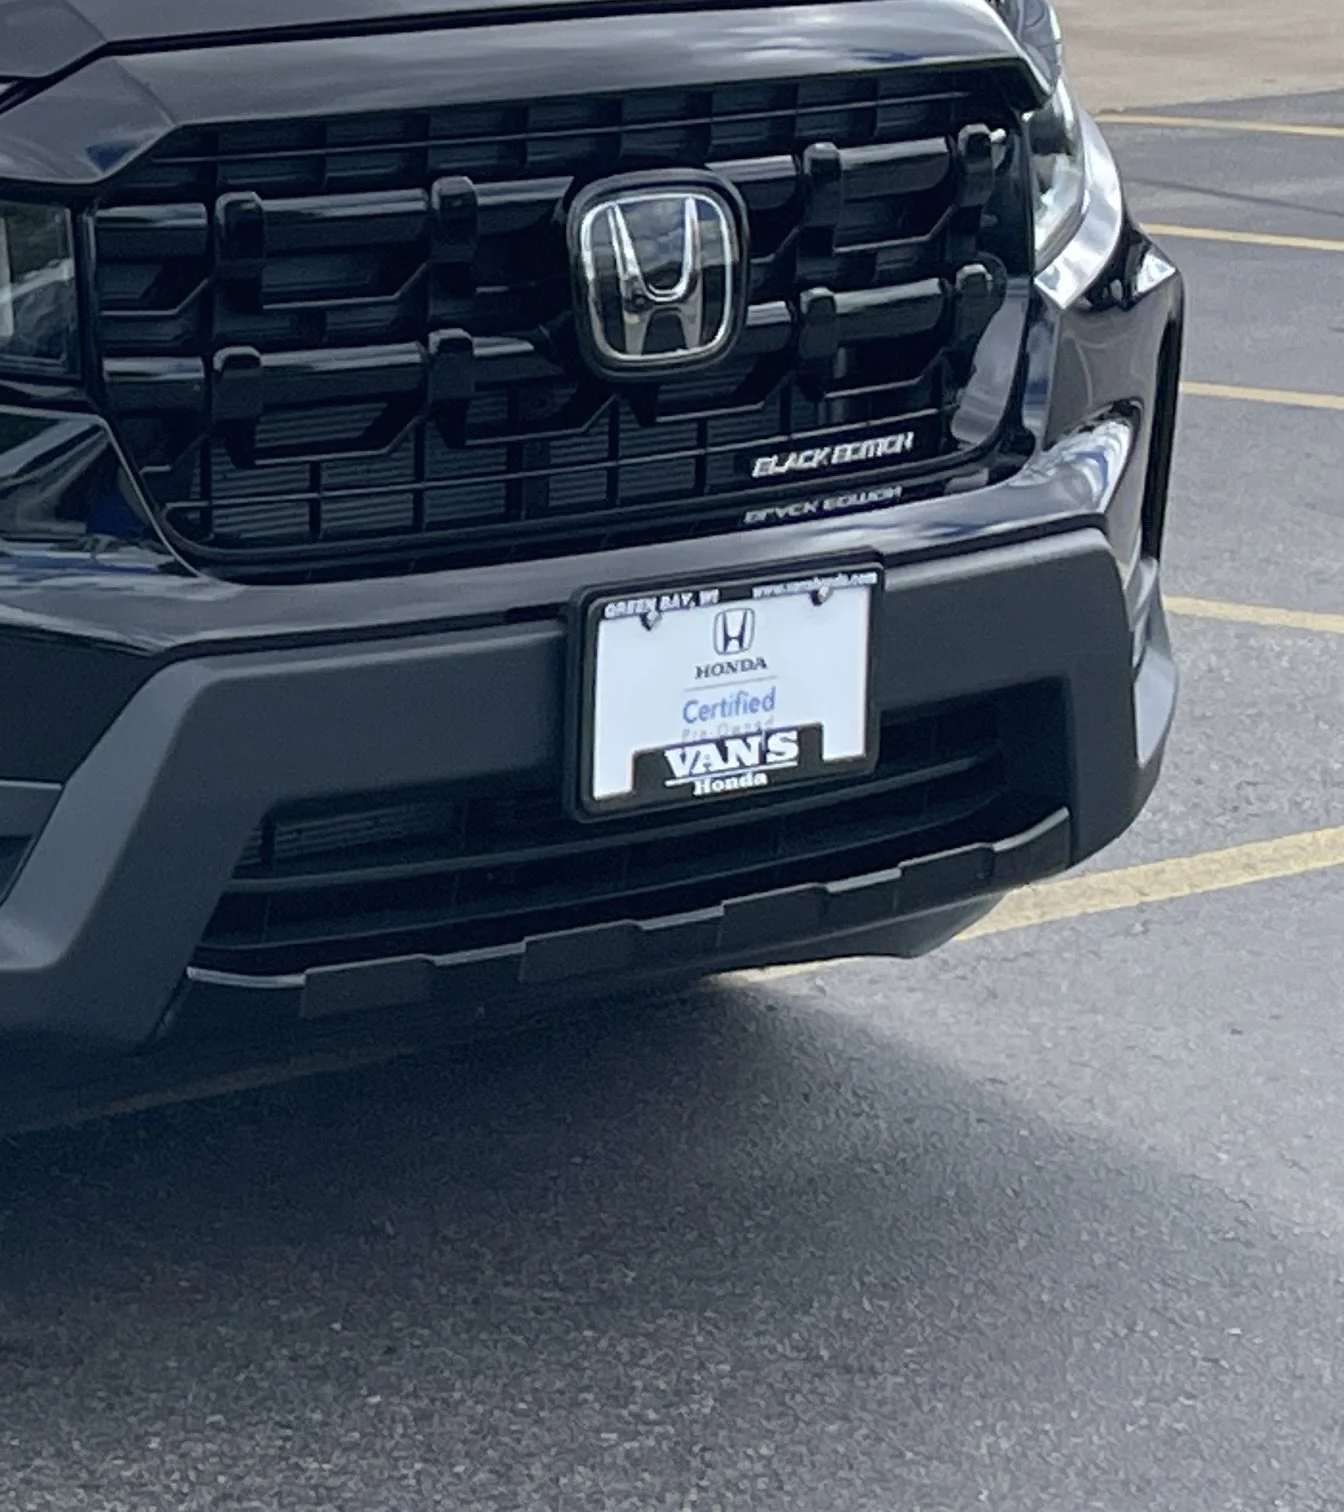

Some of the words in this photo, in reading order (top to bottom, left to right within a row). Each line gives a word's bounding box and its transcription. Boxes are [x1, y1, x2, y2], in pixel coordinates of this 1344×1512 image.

[752, 445, 831, 478] BLACK
[831, 431, 915, 465] EDITION
[694, 656, 768, 679] HONDA
[682, 686, 777, 724] Certified
[693, 772, 769, 796] Honda
